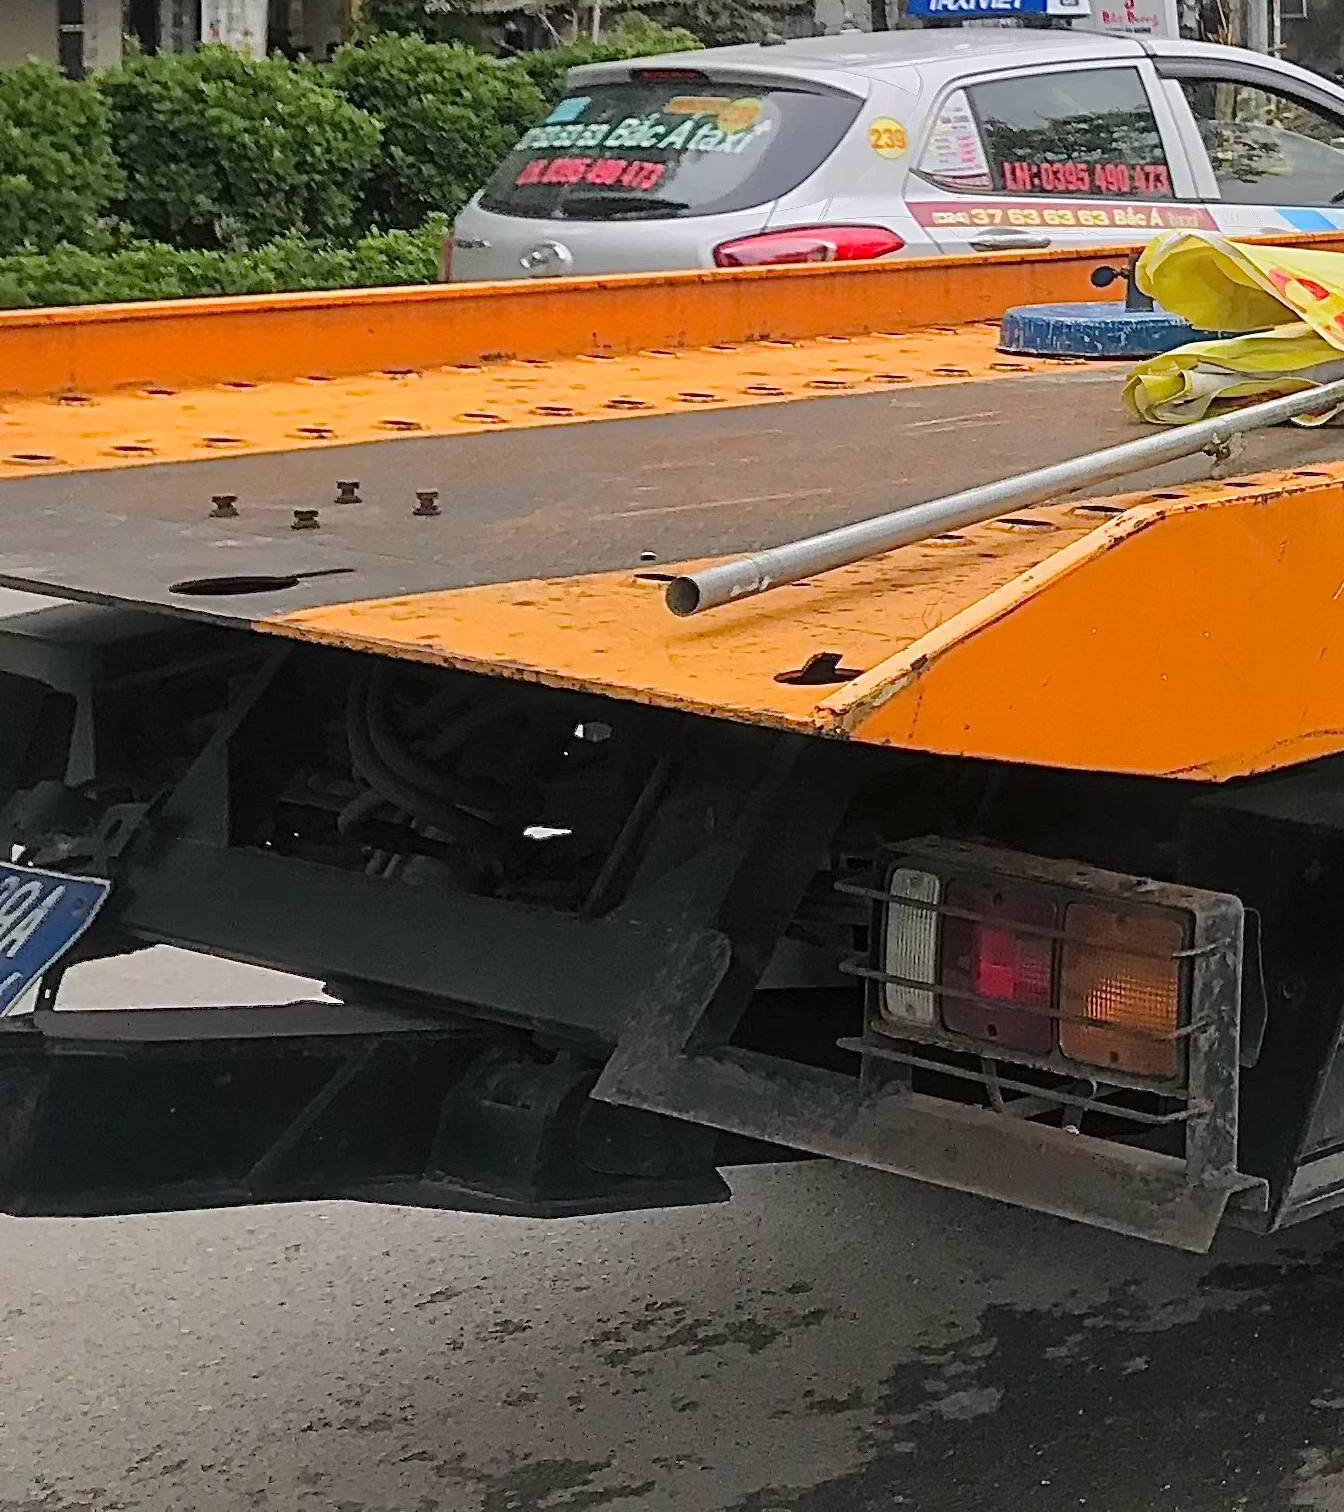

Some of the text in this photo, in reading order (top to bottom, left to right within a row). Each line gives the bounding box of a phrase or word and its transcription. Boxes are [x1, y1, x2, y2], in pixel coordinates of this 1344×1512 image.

[1095, 164, 1129, 192] 490
[1134, 164, 1168, 192] 473
[1008, 209, 1041, 226] 63
[1043, 209, 1075, 226] 63
[1078, 210, 1110, 226] 63
